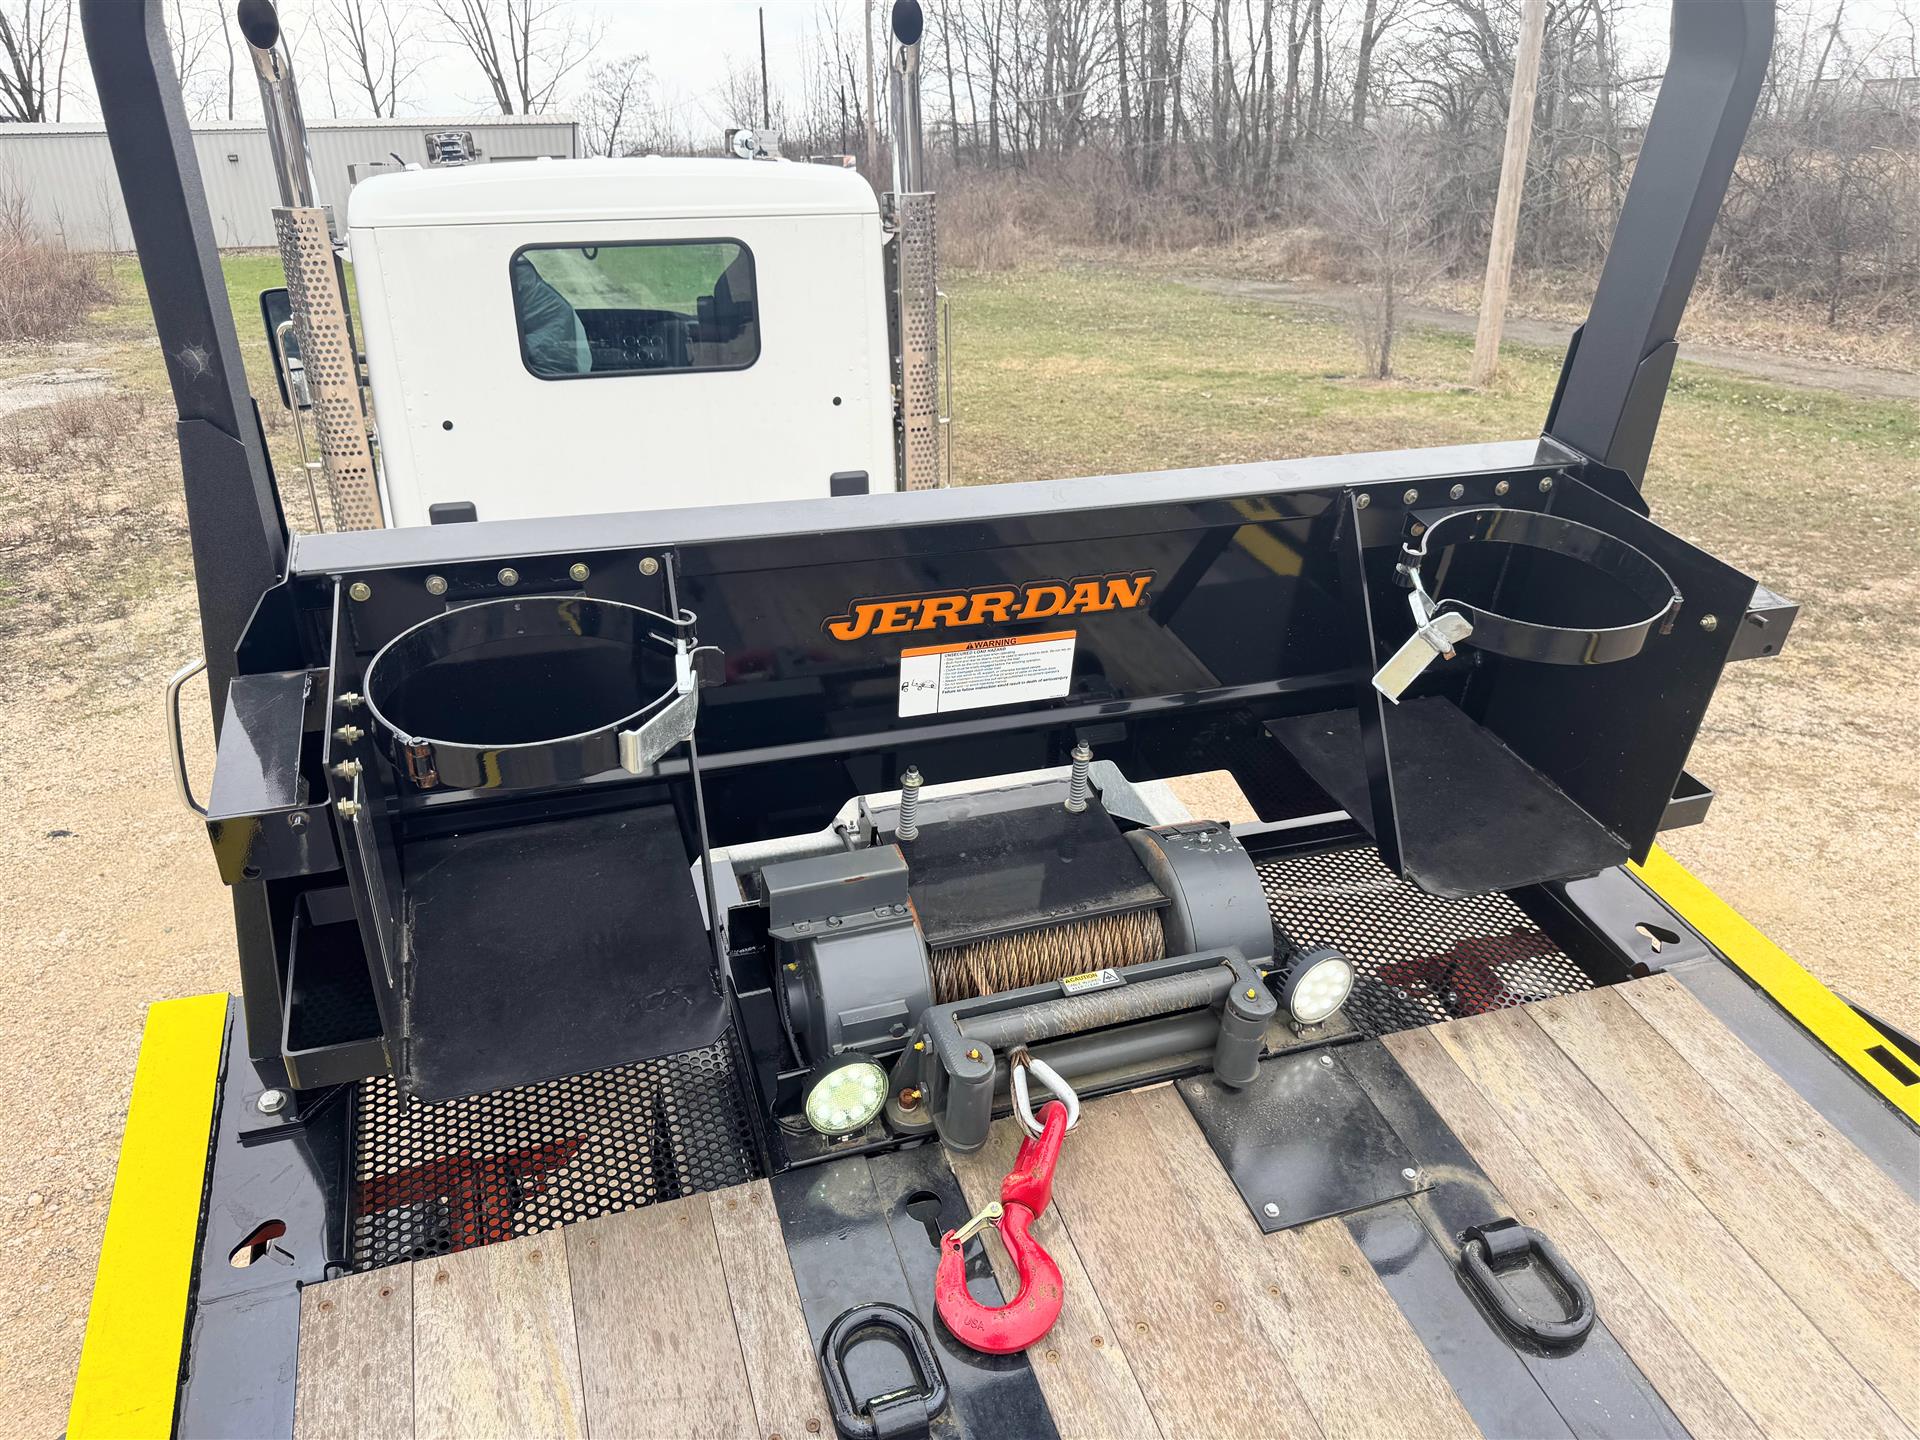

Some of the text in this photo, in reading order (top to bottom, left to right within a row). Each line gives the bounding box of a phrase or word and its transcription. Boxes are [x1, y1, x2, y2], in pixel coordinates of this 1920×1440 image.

[828, 577, 1152, 641] JERR-DAN
[975, 638, 1017, 648] WARNING
[1070, 973, 1098, 982] CAUTION
[964, 1315, 985, 1331] USA
